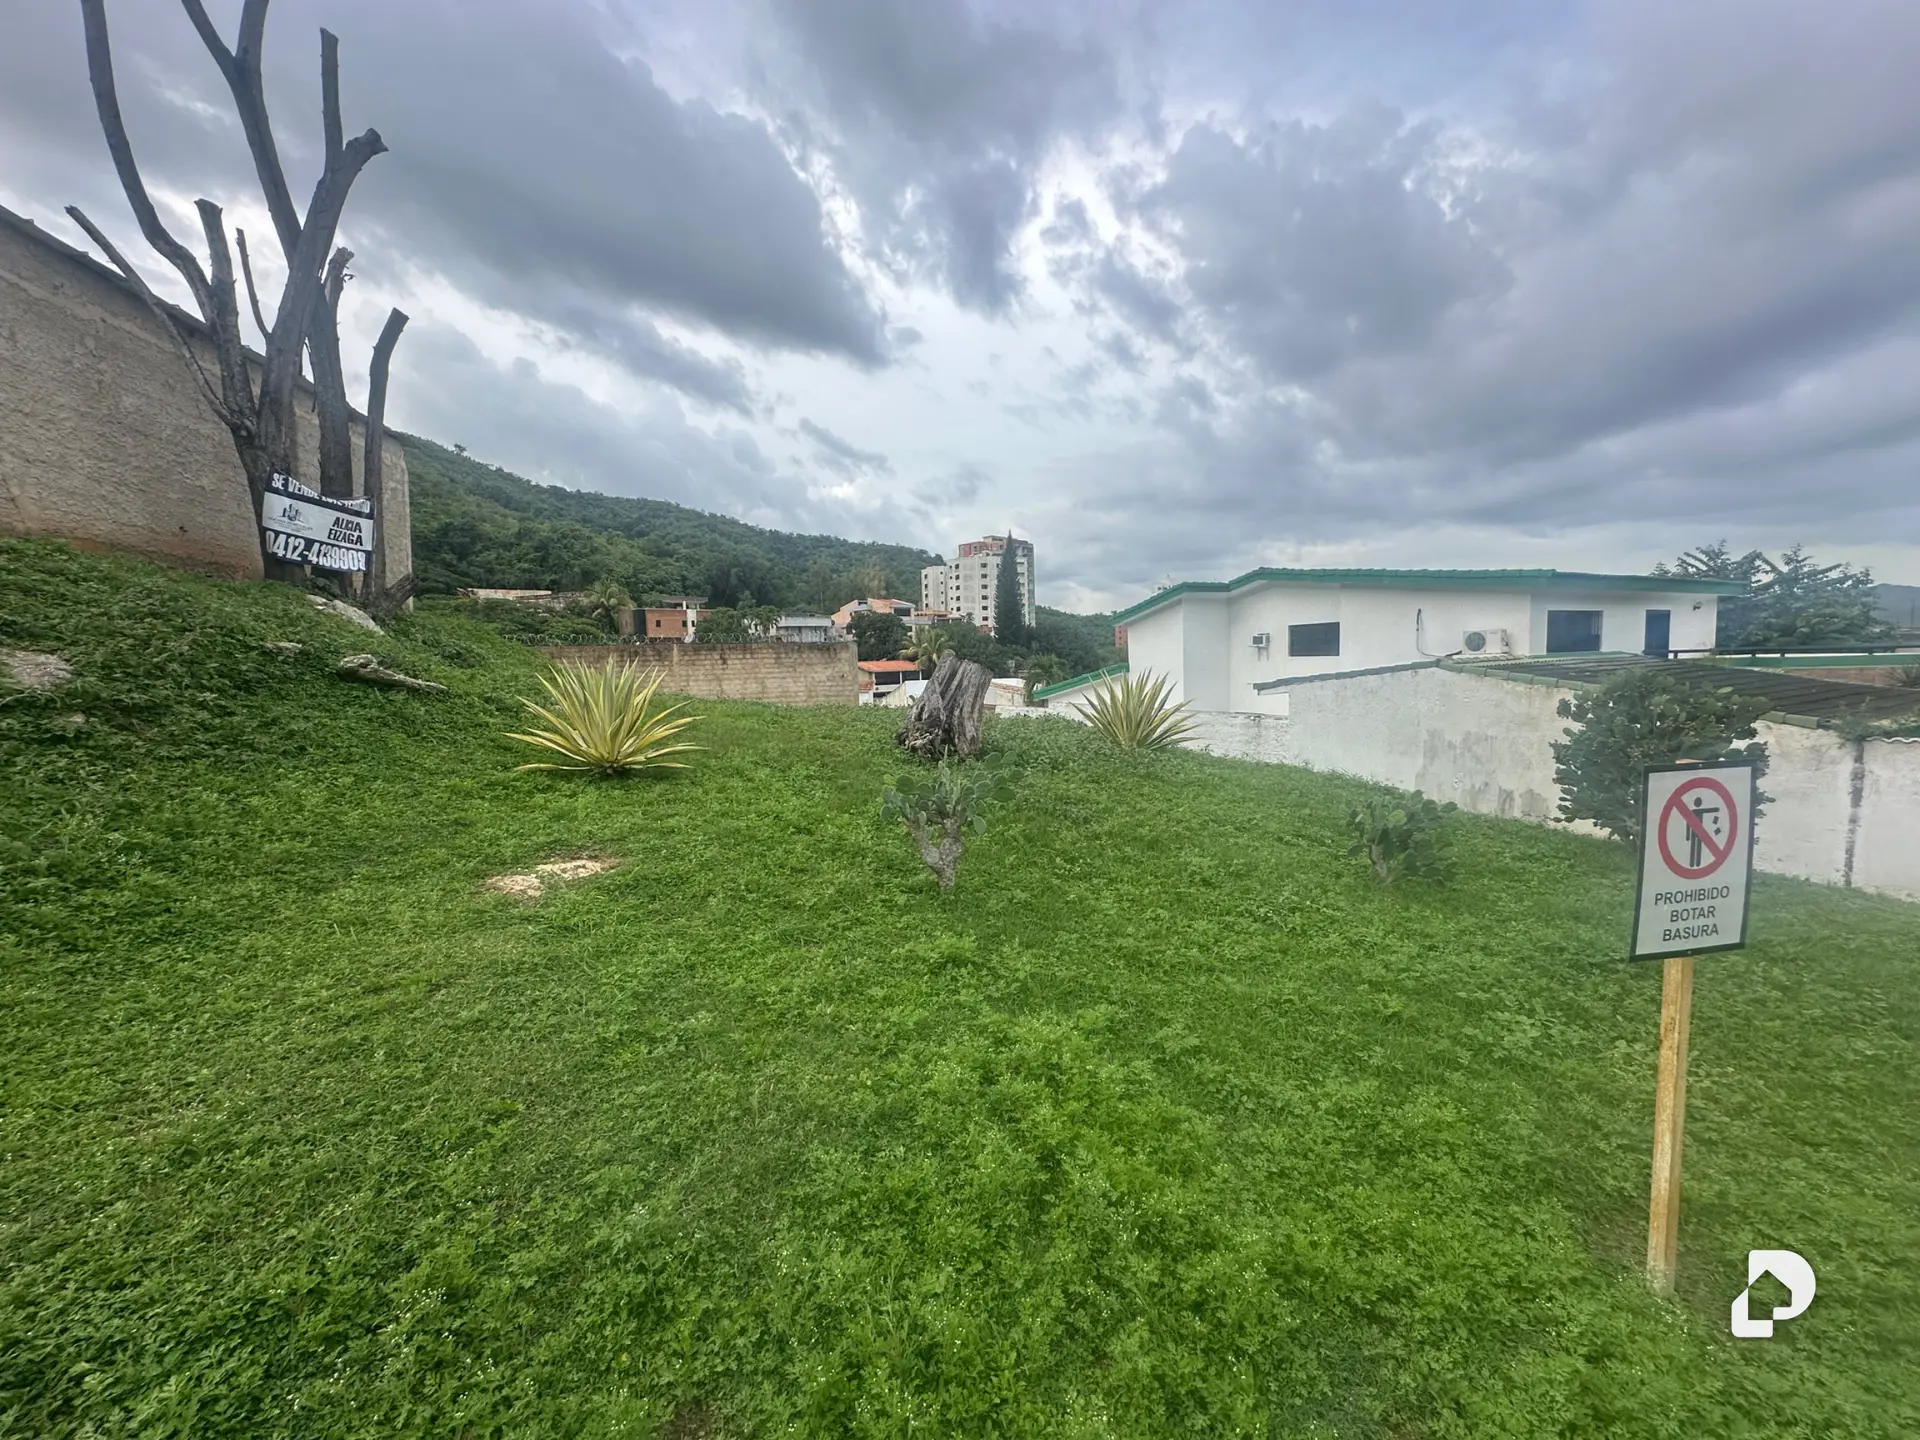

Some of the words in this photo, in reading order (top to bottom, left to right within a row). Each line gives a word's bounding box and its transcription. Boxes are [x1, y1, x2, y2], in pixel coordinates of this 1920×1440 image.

[271, 473, 286, 490] SE
[332, 516, 363, 534] ALICIA
[327, 528, 364, 547] EIZAGA
[1654, 885, 1730, 906] PROHIBIDO
[1670, 905, 1716, 922] BOTAR
[1662, 923, 1719, 942] BASURA
